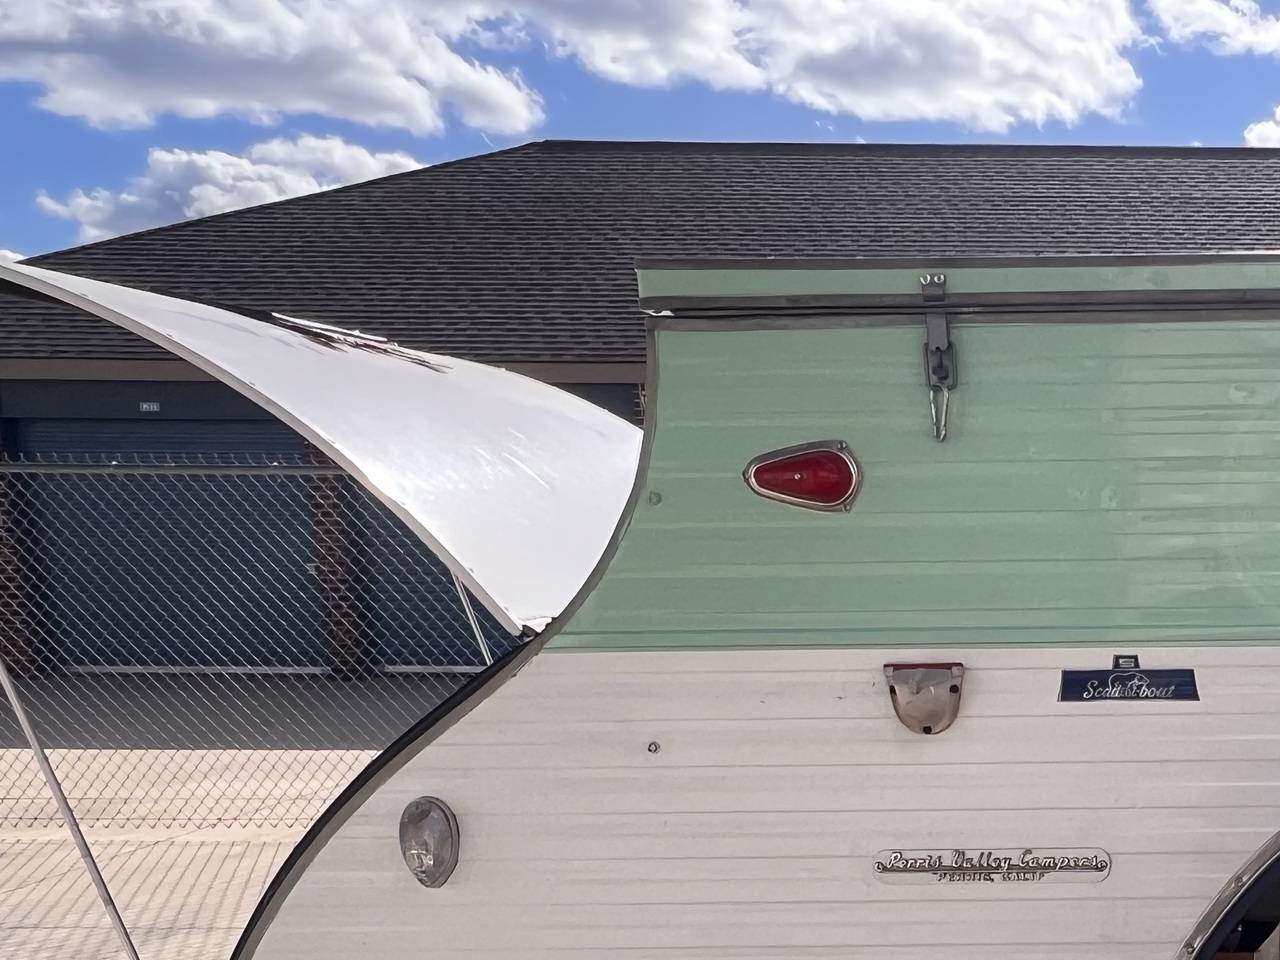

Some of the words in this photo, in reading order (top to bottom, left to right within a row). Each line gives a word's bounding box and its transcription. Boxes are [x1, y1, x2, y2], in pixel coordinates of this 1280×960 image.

[888, 851, 942, 869] Perris
[952, 849, 1012, 872] Valley
[1019, 849, 1098, 870] Campers
